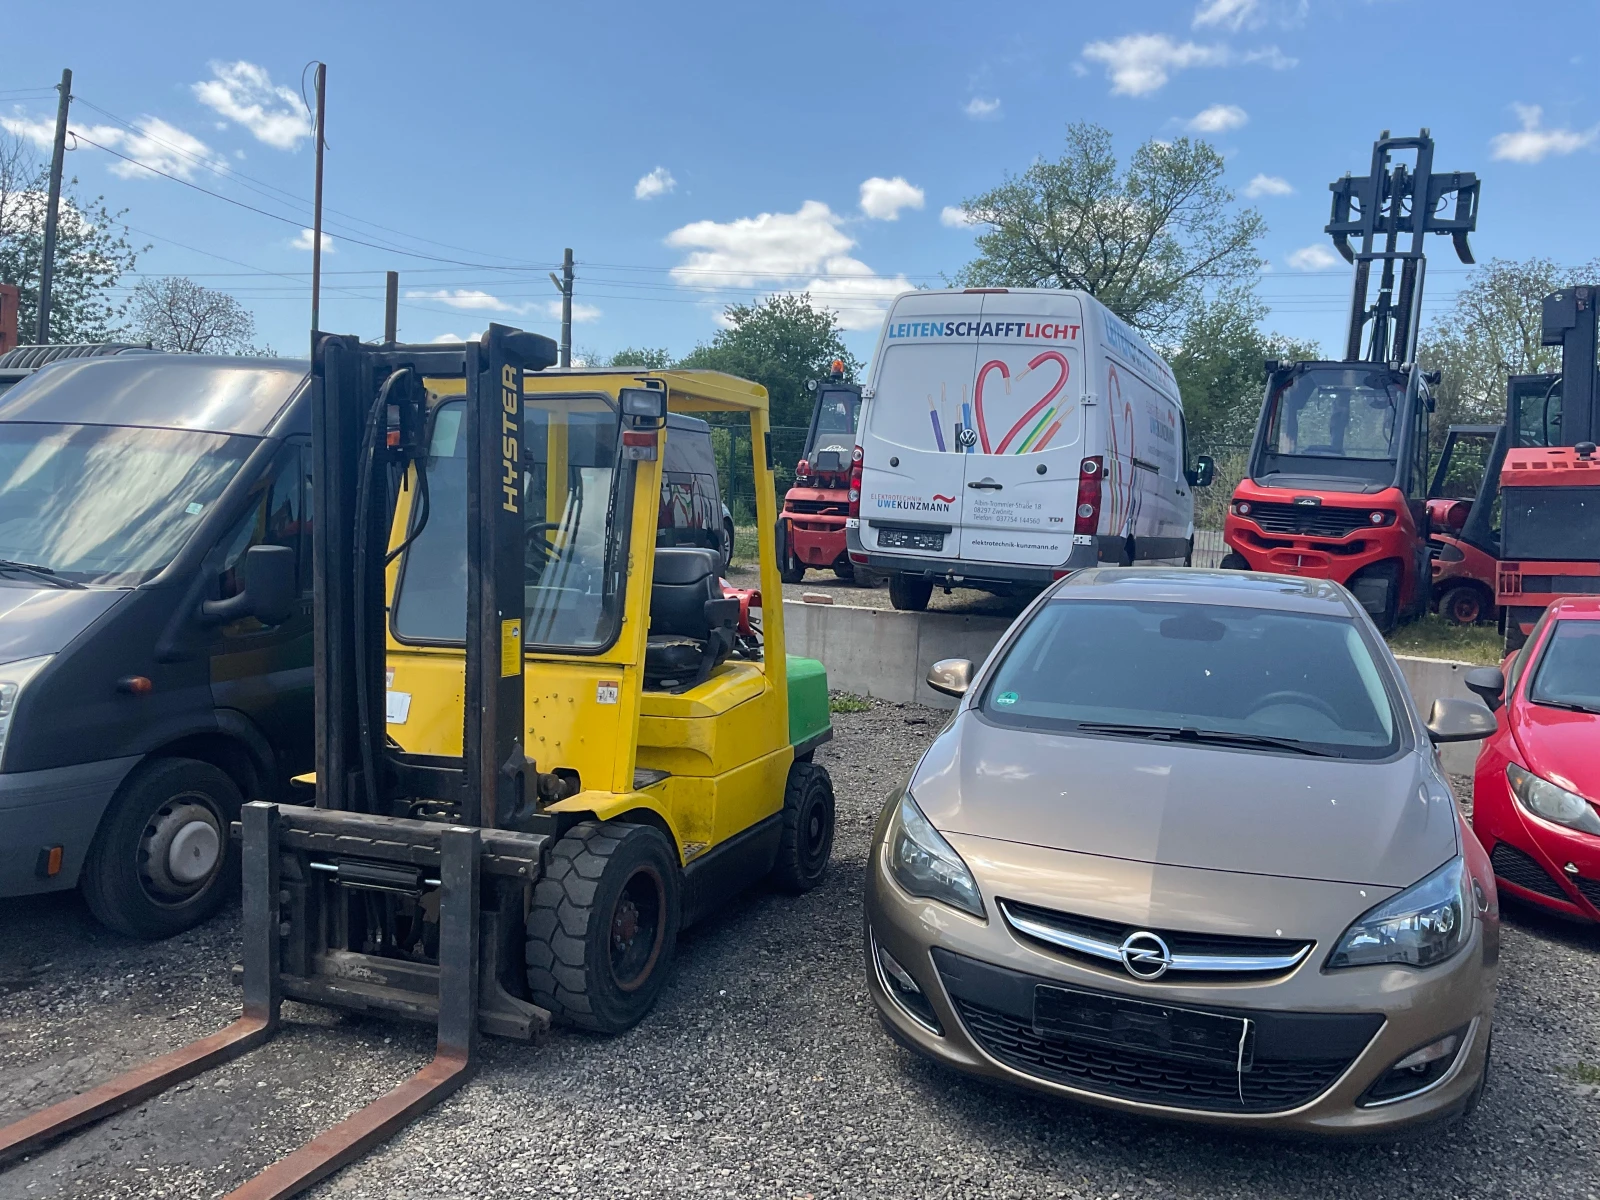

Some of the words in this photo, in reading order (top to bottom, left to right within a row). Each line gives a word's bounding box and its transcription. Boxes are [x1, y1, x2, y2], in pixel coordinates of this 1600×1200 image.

[888, 321, 1081, 340] LEITENSCHAFFTLICHT
[502, 363, 518, 513] HYSTER
[870, 493, 922, 502] ELEKTROTECHNIK
[877, 499, 950, 512] UWEKUNZMANN
[973, 506, 991, 514] 08297
[996, 515, 1018, 523] 037754
[971, 540, 1059, 551] elektrotechnik-kunzmann.de
